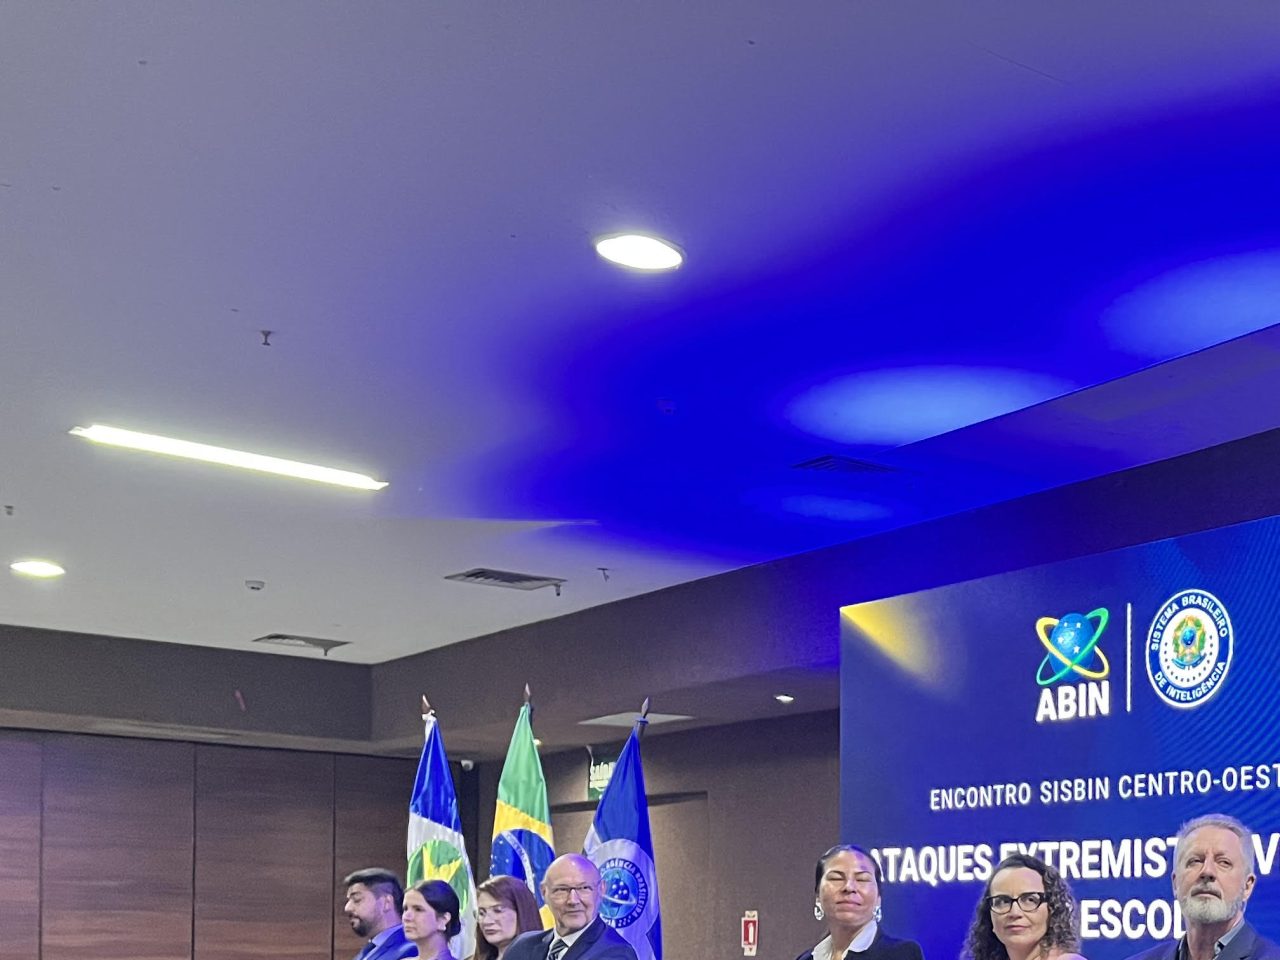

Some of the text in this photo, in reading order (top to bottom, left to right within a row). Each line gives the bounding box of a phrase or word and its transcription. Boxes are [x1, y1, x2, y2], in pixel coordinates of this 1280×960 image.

[1151, 594, 1228, 651] SISTEMA BRASILEIRO
[1035, 680, 1110, 723] ABIN
[1154, 661, 1226, 702] DE INTELIGÊNCIA
[929, 782, 1031, 811] ENCONTRO
[1039, 776, 1110, 804] SISBIN
[1080, 898, 1187, 940] ESCOL
